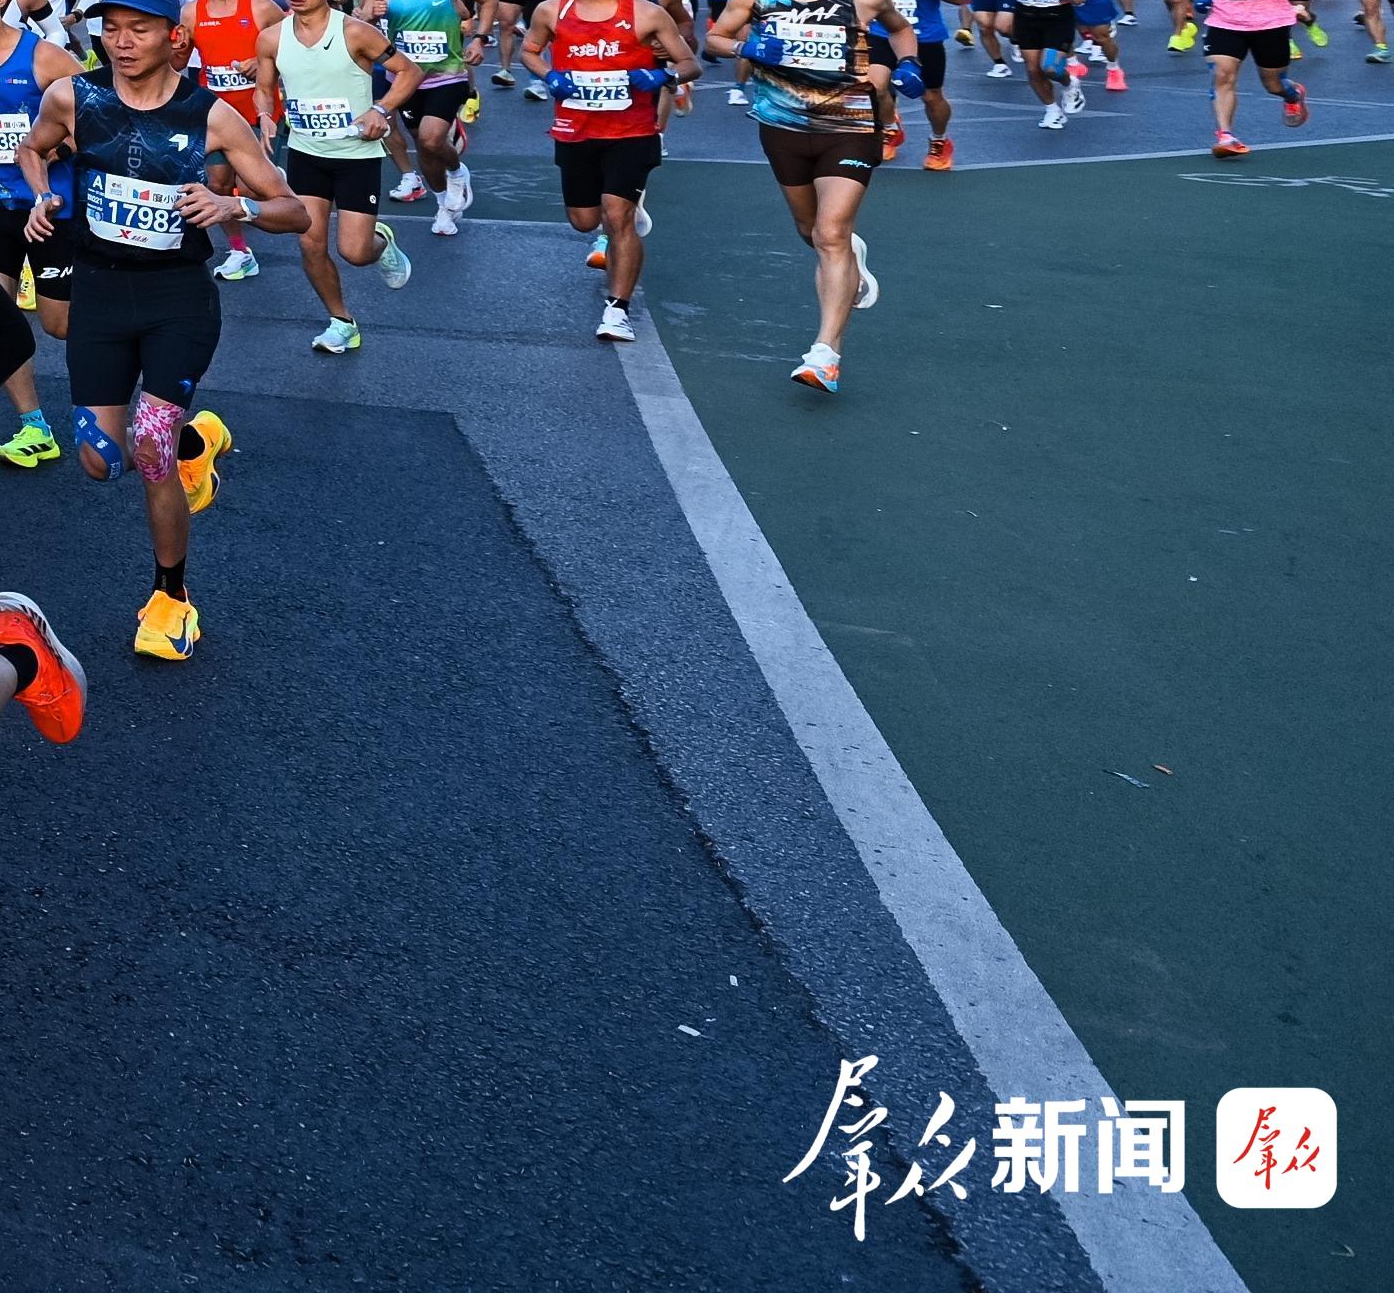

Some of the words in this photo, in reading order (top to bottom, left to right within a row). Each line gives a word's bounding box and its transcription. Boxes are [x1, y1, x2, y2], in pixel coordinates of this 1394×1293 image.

[765, 24, 775, 34] A
[406, 43, 444, 54] 10251
[782, 41, 843, 59] 22996
[214, 74, 254, 87] 1306
[301, 113, 348, 129] 16591
[92, 174, 103, 190] A
[108, 200, 182, 234] 17982
